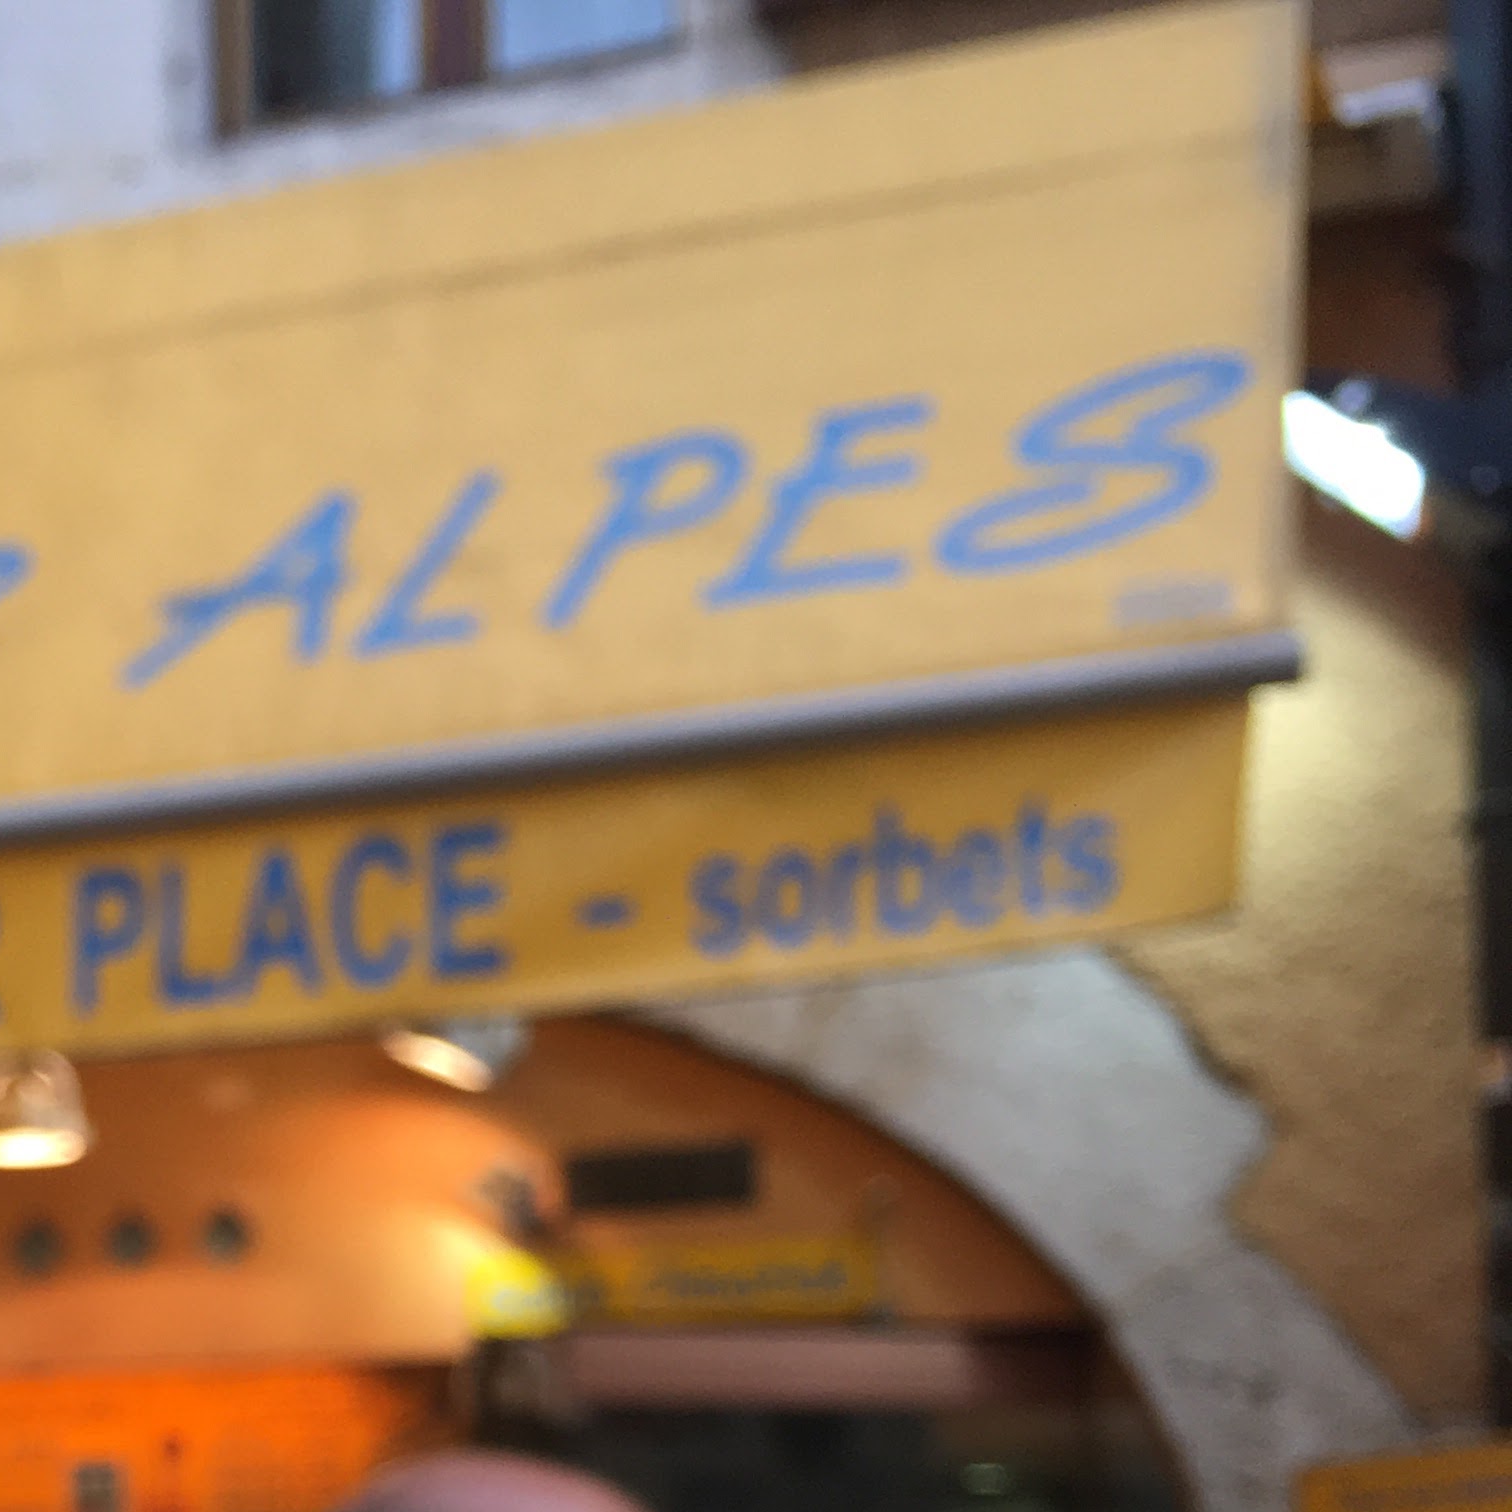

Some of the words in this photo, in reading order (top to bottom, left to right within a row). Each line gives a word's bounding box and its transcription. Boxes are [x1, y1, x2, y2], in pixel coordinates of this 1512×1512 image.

[116, 348, 1254, 690] ALPES
[70, 819, 514, 1020] PLACE
[690, 797, 1124, 960] sorbets
